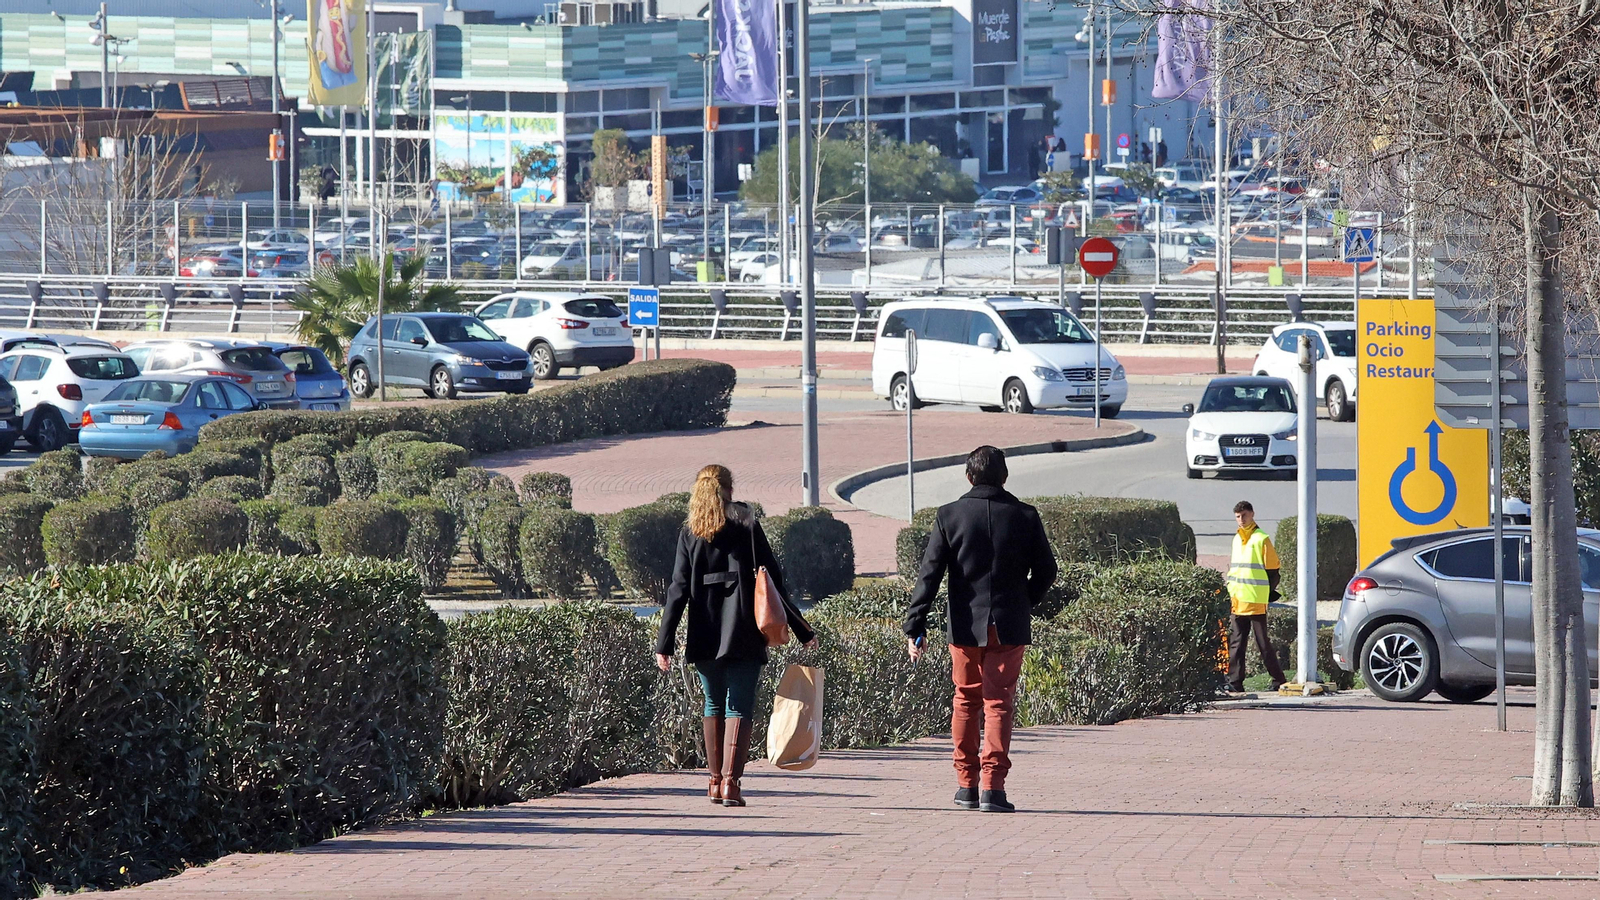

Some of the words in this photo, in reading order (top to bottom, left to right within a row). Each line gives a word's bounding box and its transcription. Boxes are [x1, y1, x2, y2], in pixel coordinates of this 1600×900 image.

[978, 9, 1010, 25] Muerde
[630, 294, 658, 303] SALIDA
[1366, 321, 1431, 340] Parking
[1366, 343, 1404, 357] Ocio
